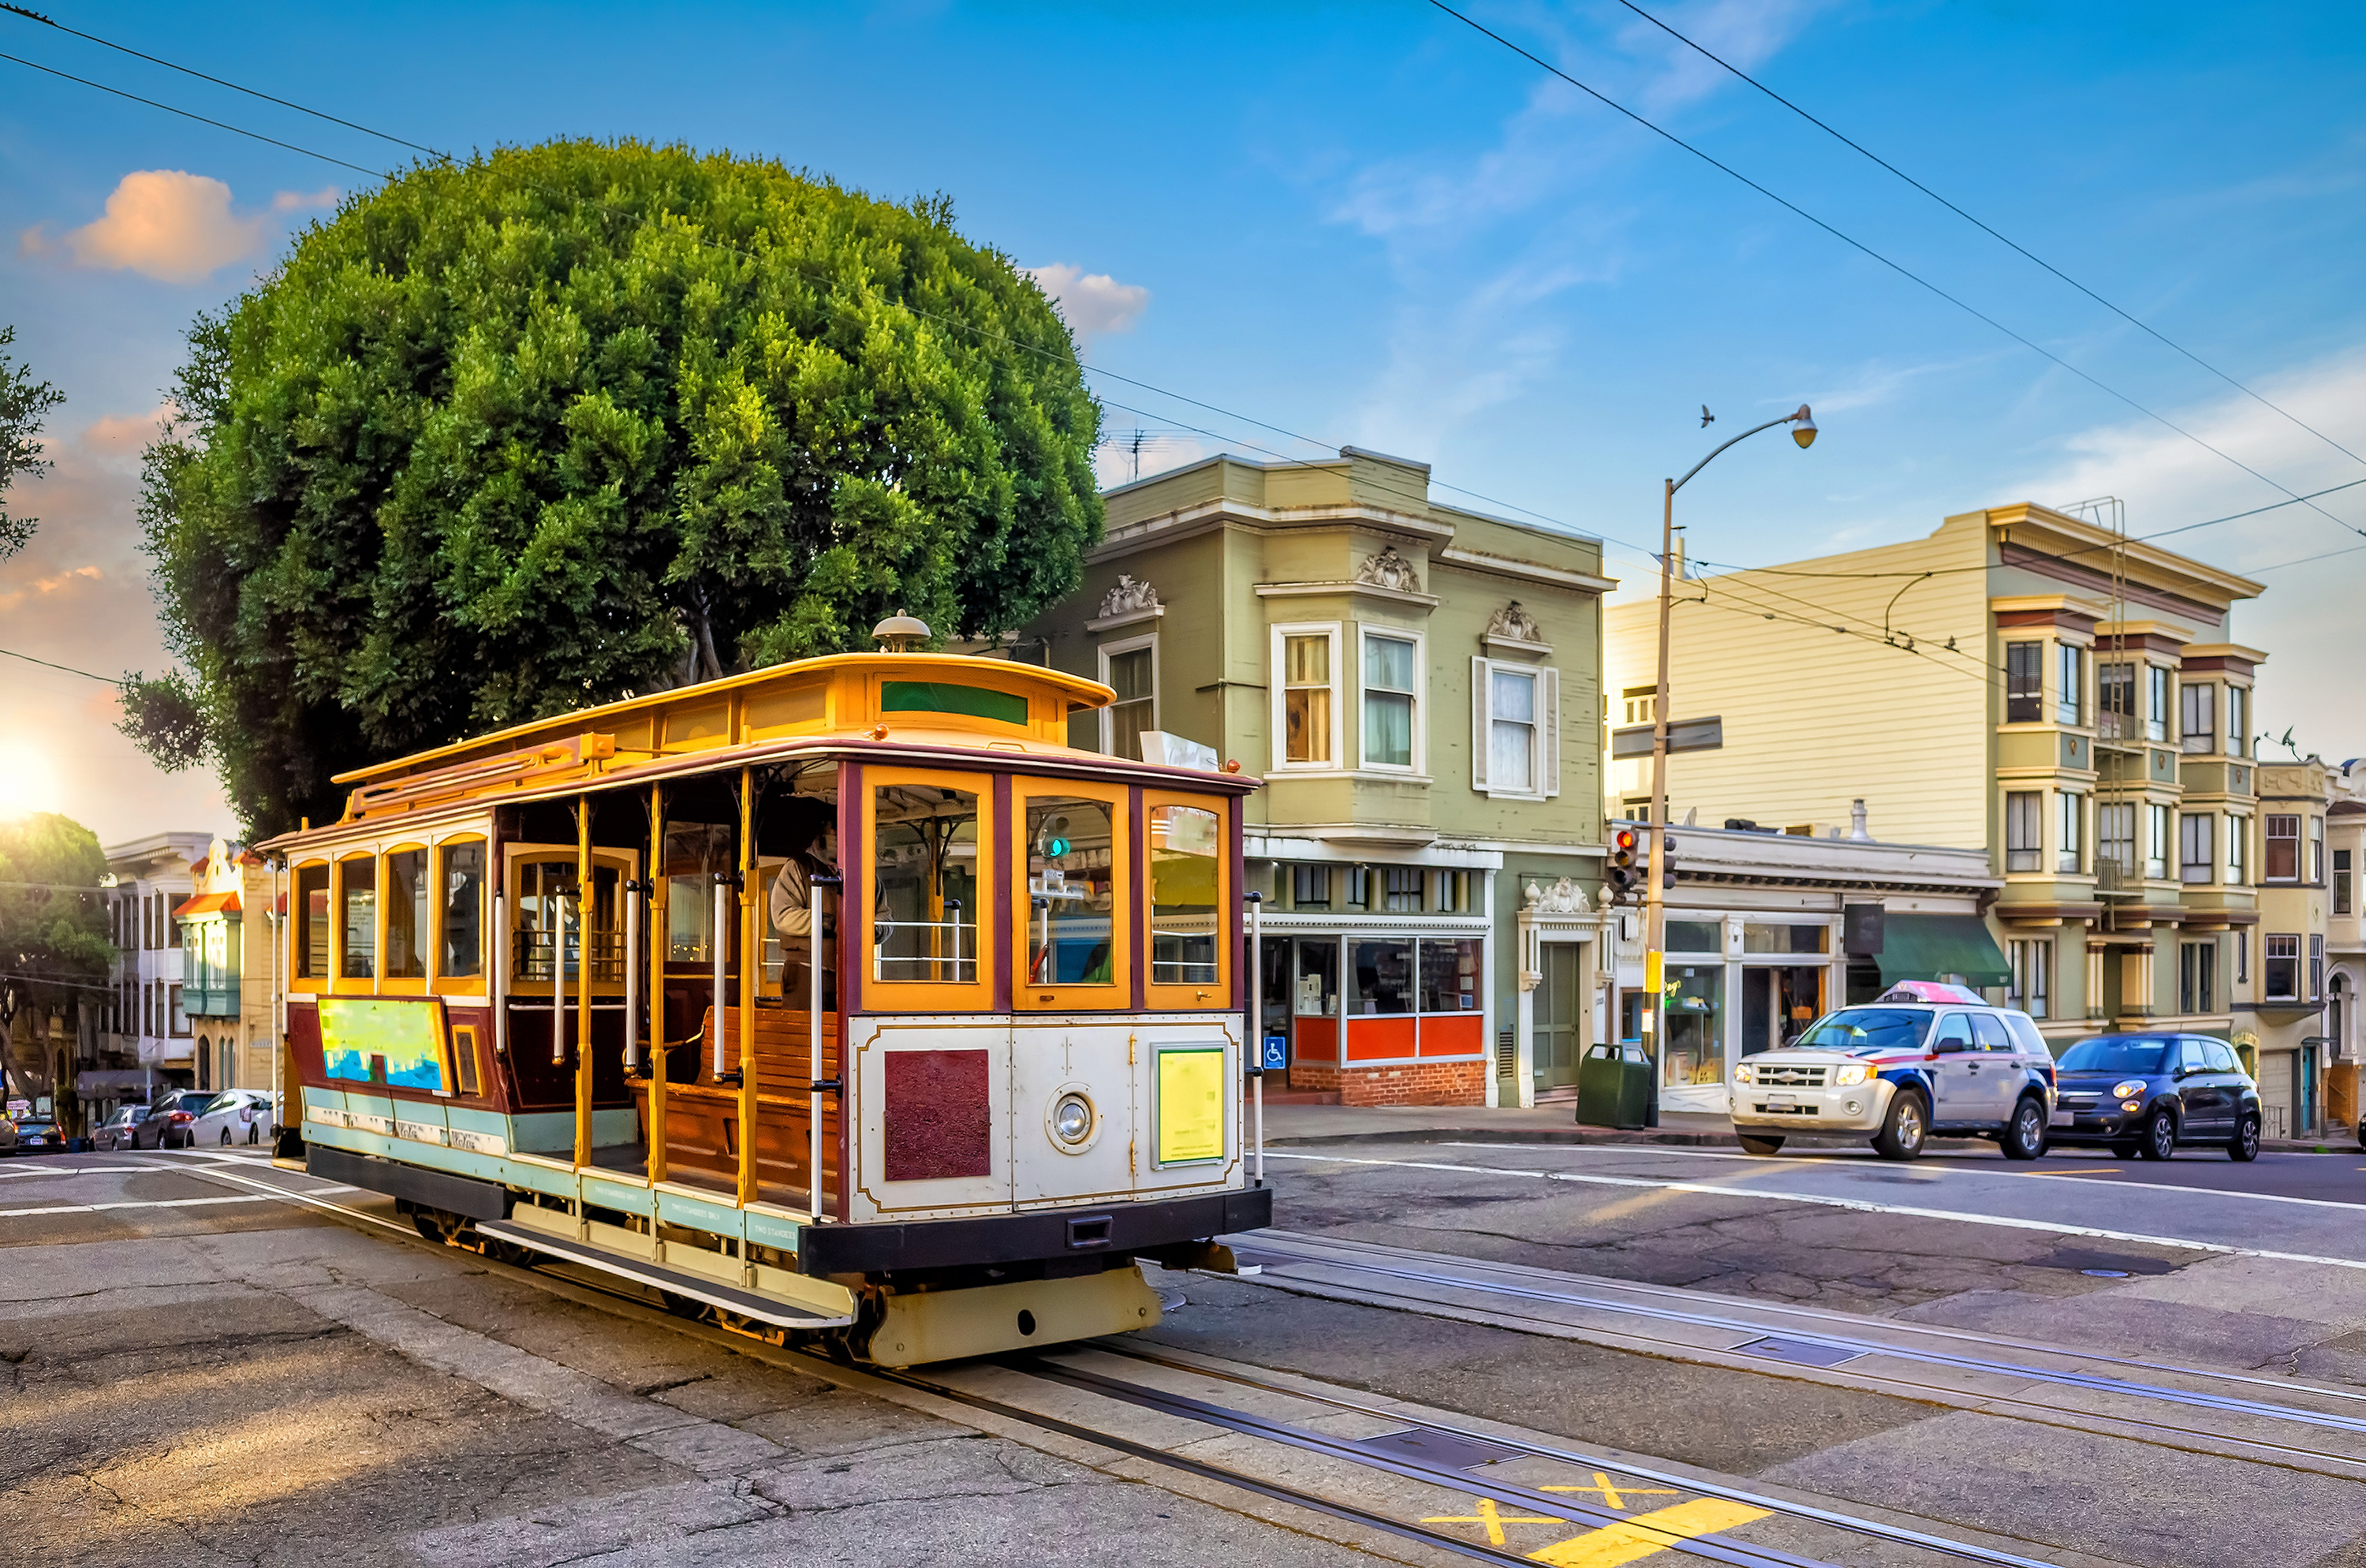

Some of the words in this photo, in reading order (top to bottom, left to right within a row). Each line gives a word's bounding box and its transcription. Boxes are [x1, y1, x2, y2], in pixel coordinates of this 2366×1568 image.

[671, 1203, 681, 1211] TWO
[682, 1205, 707, 1218] STANDEES
[707, 1211, 719, 1220] ONLY
[755, 1225, 767, 1235] TWO
[767, 1227, 795, 1240] STANDEES
